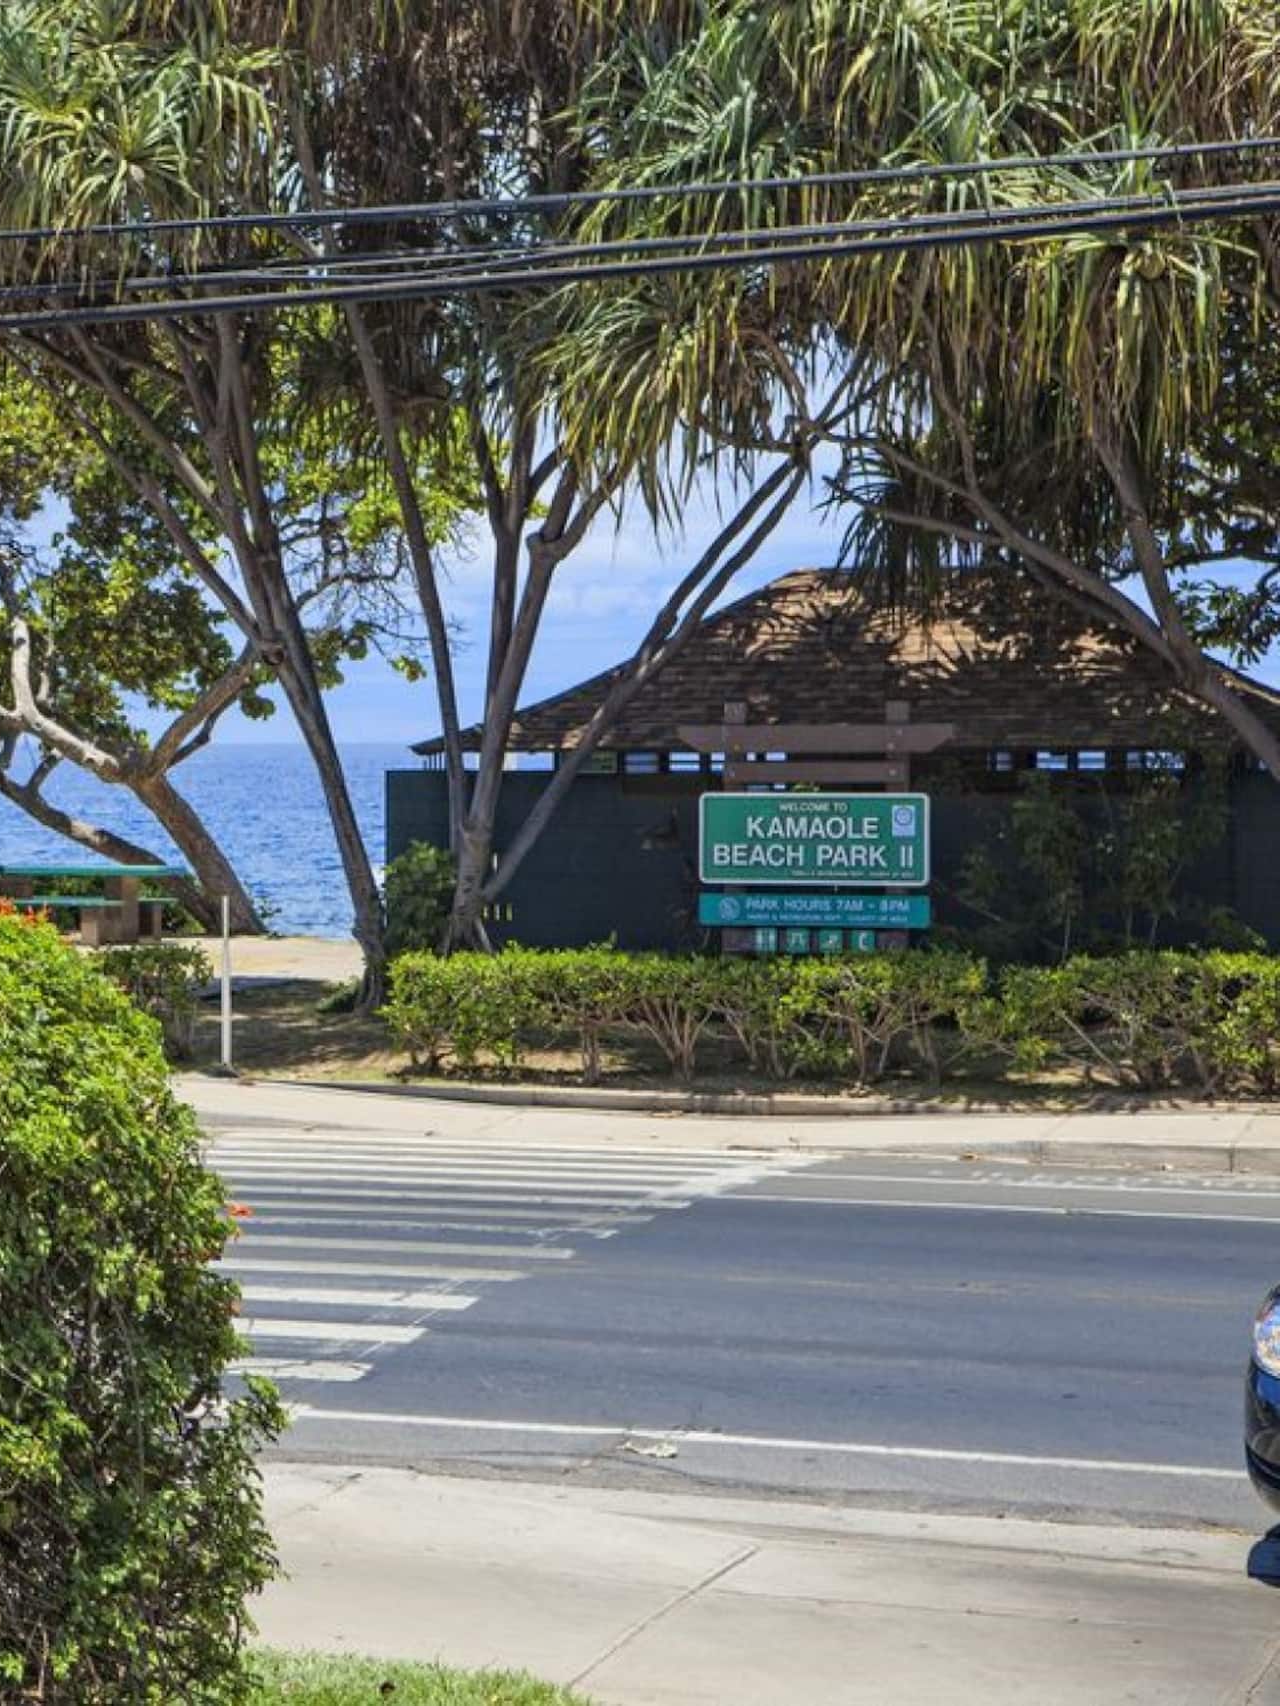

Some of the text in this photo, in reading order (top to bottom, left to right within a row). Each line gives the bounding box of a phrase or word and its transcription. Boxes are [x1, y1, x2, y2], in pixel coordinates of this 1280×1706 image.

[778, 801, 849, 813] WELCOME TO
[745, 816, 880, 840] KAMAOLE
[712, 843, 805, 867] BEACH
[815, 845, 887, 868] PARK
[745, 898, 780, 912] PARK
[783, 898, 832, 913] HOURS
